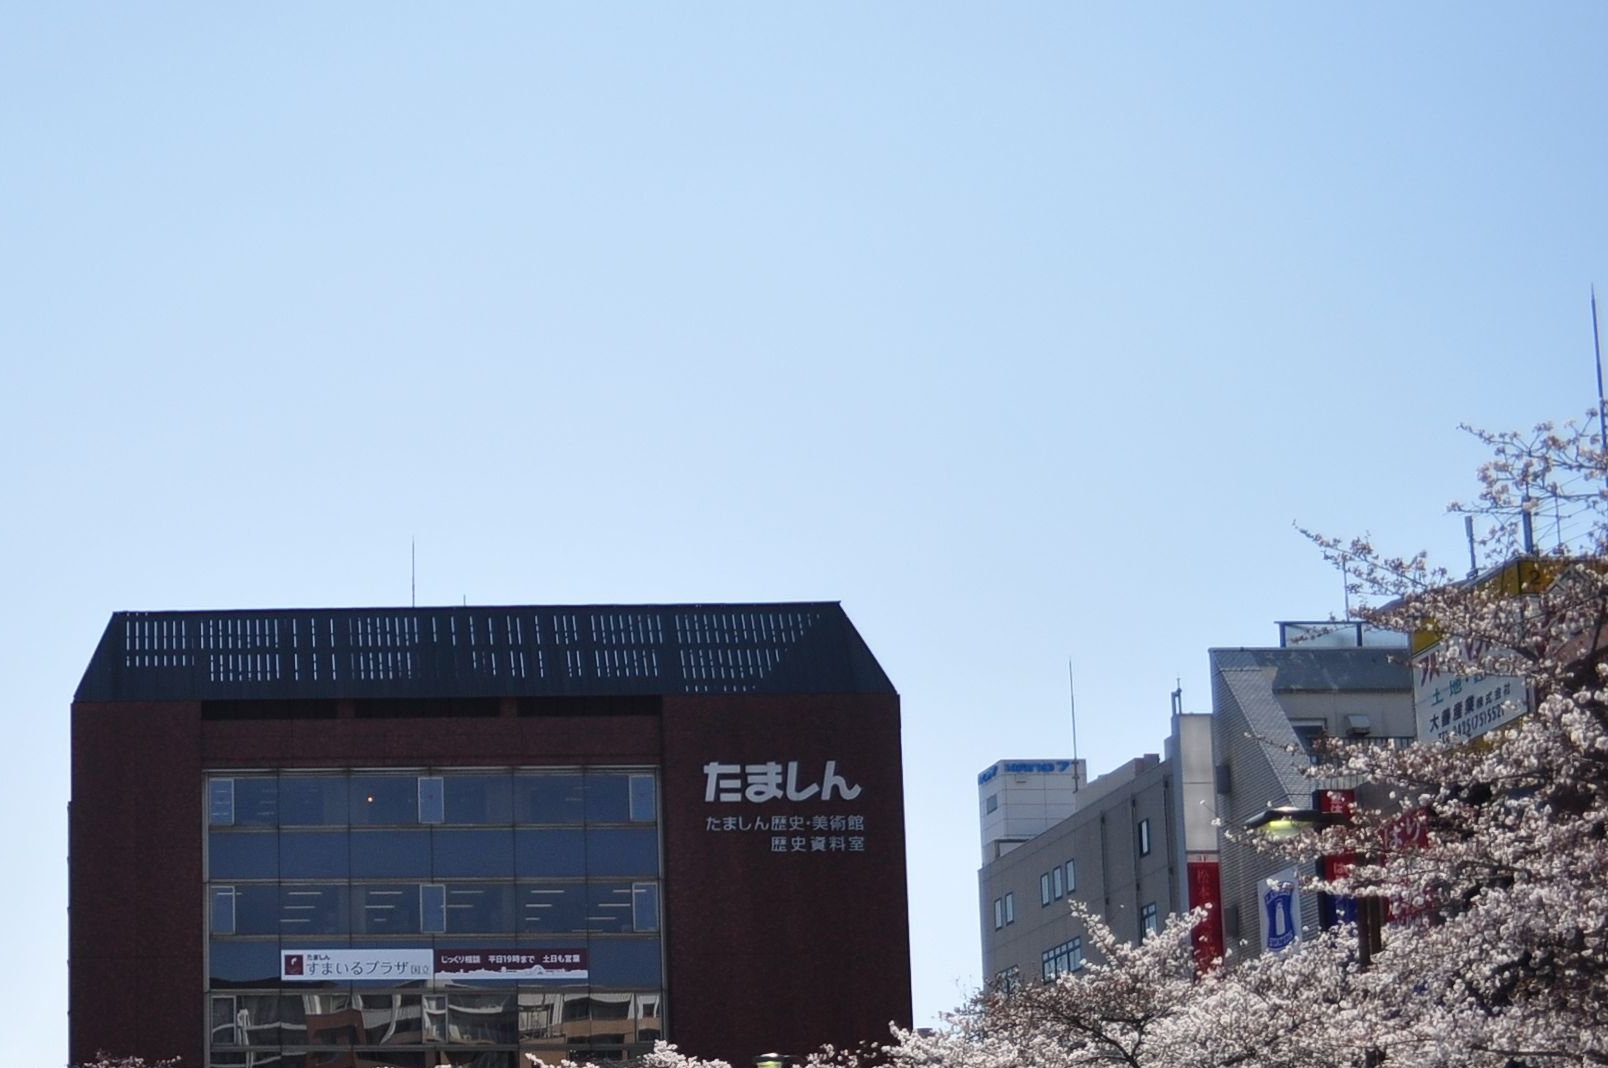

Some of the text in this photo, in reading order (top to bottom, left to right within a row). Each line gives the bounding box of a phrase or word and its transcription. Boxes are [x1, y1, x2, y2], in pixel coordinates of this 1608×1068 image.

[703, 760, 862, 803] たましん
[706, 815, 865, 832] たましん歴史・美術館
[771, 836, 865, 852] 歴史資料室
[306, 961, 408, 976] すまいるプラザ
